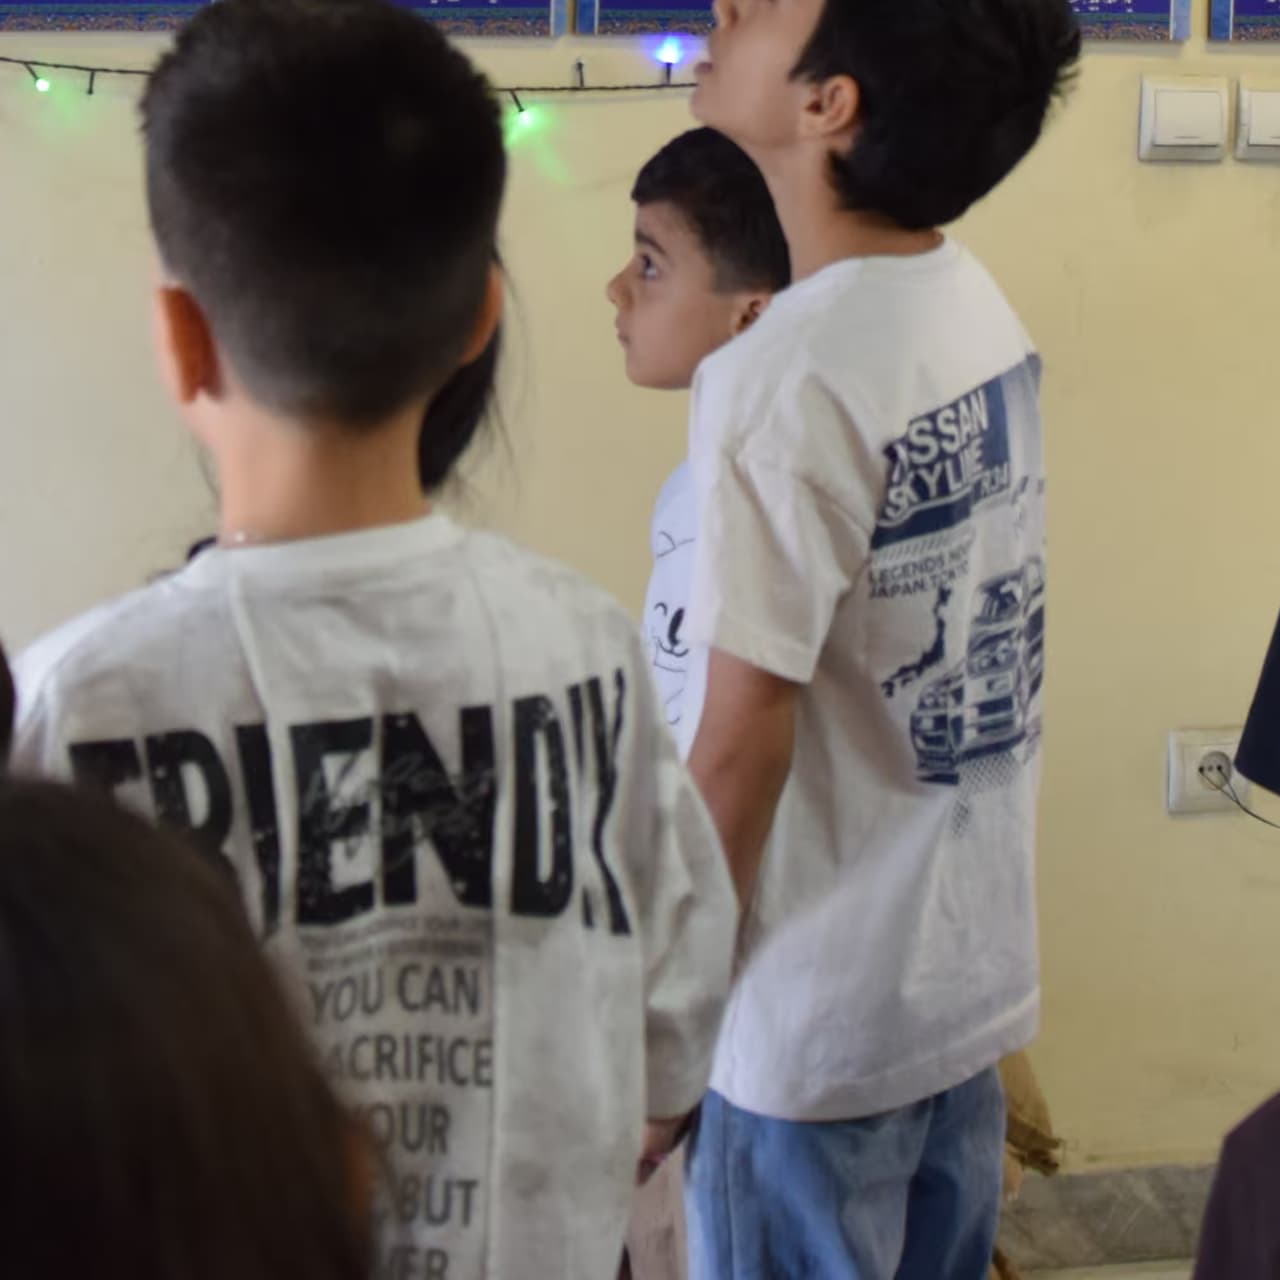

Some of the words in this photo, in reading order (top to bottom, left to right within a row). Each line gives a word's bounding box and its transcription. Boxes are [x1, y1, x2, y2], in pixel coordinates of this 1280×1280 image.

[309, 975, 383, 1024] YOU
[397, 963, 480, 1014] CAN
[368, 1103, 452, 1156] OUR
